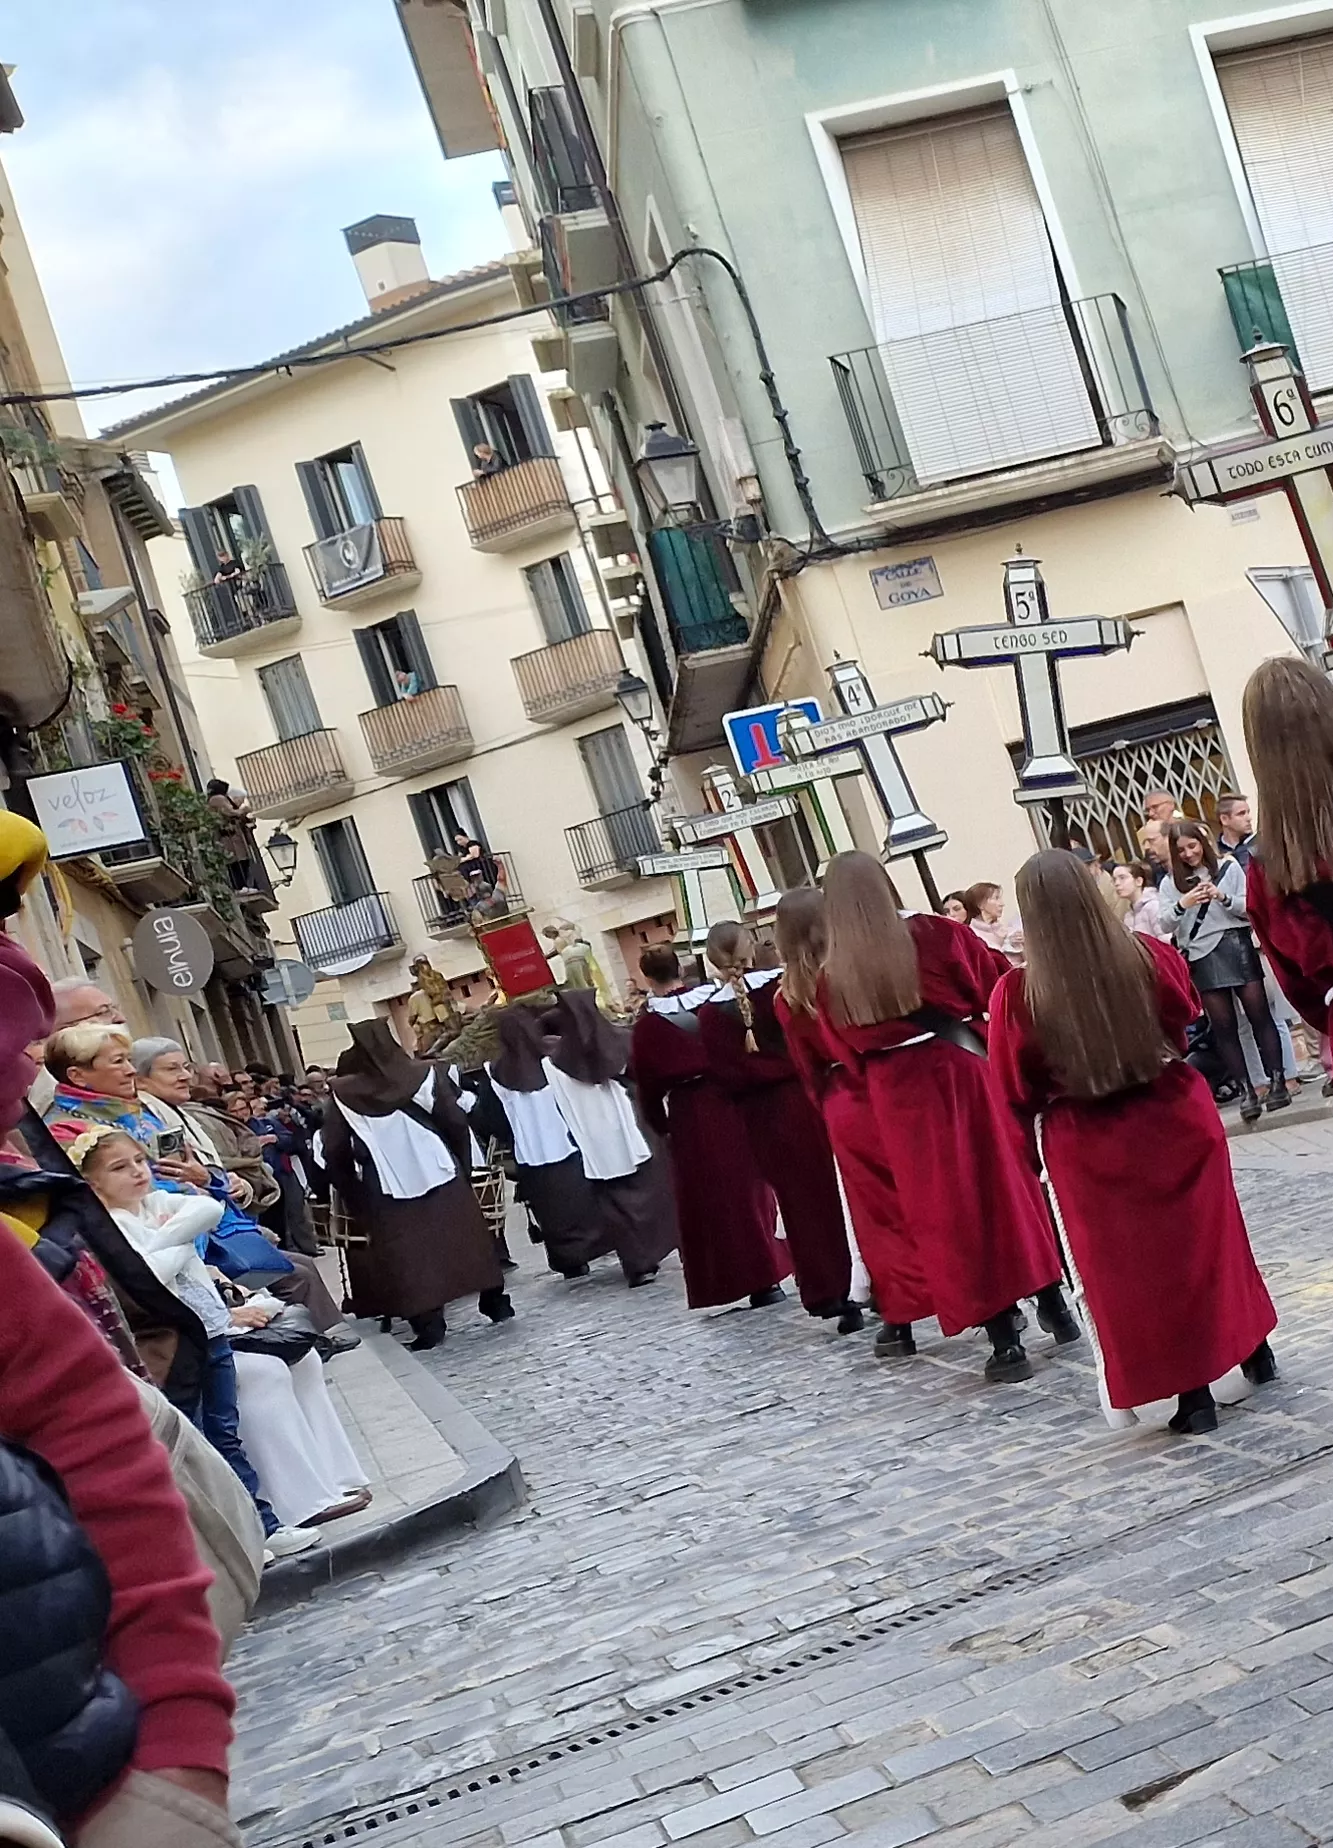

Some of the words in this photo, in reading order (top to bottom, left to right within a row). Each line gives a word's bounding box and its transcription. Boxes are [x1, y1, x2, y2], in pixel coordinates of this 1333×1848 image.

[1227, 460, 1264, 479] TODO
[1268, 450, 1301, 469] ESTA
[888, 587, 931, 604] GOYA
[993, 633, 1037, 650] TENGO
[1042, 629, 1068, 645] SED
[47, 775, 117, 815] veloz
